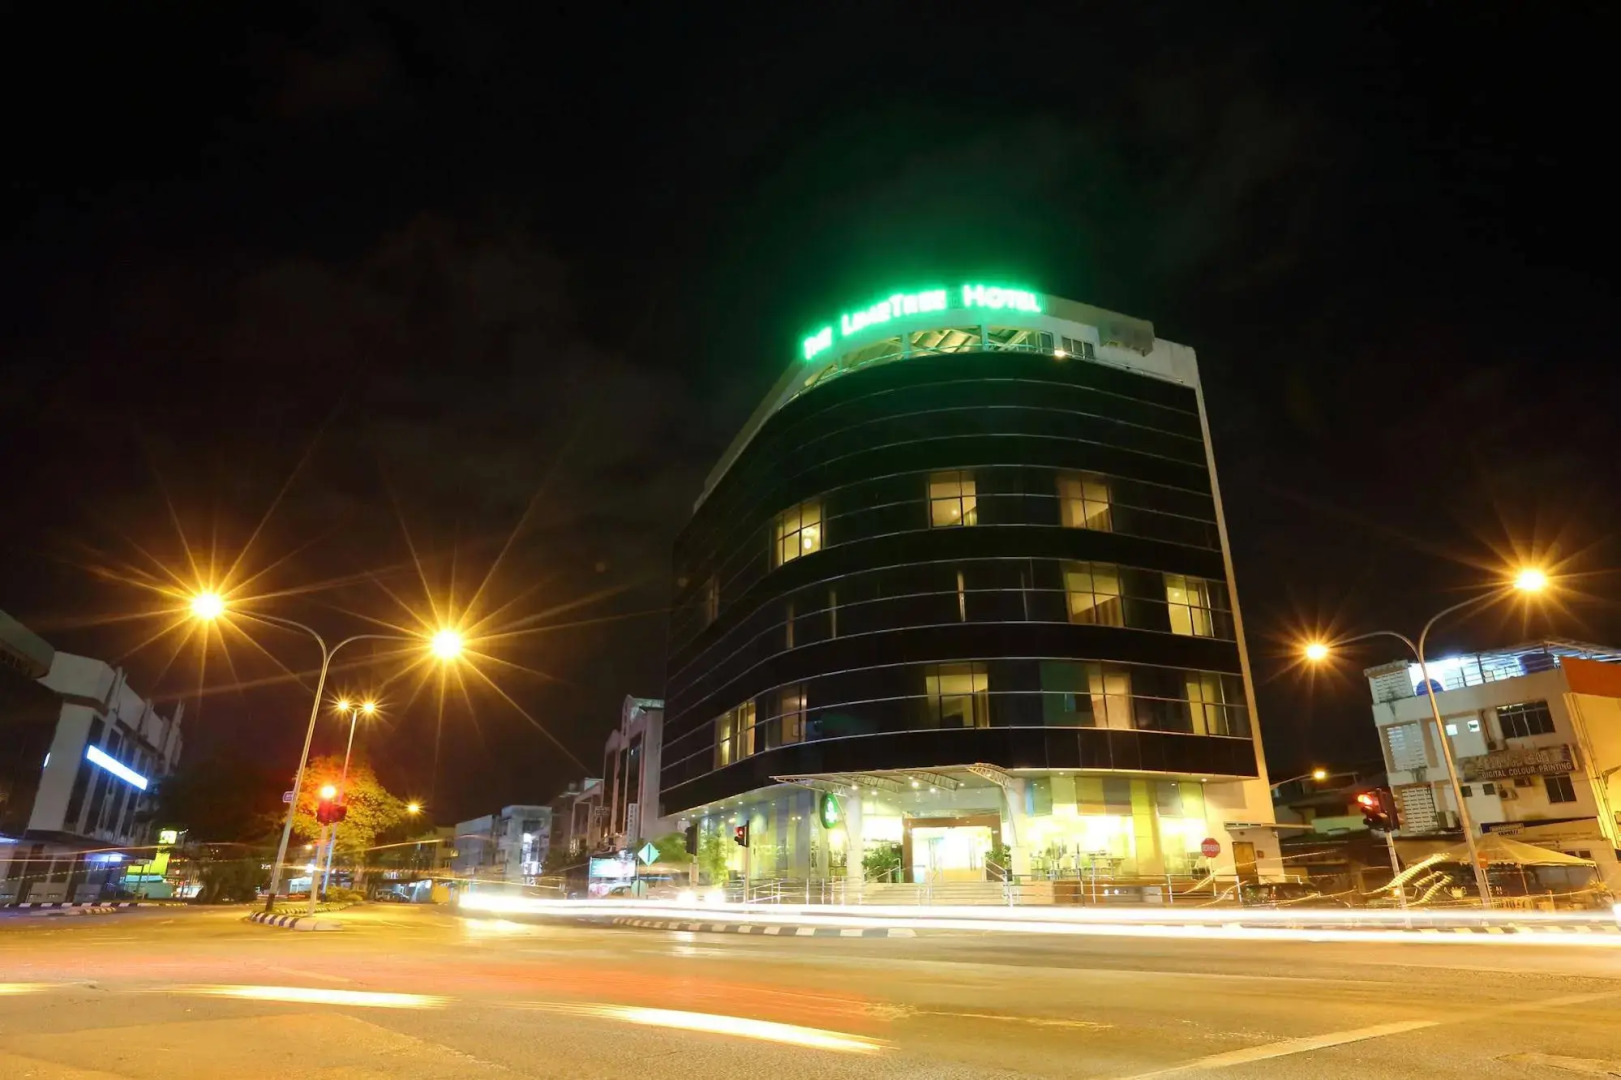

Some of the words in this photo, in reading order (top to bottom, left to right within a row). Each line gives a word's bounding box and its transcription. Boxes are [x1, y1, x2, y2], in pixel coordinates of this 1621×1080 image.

[963, 285, 1041, 313] HOTEL
[1481, 770, 1506, 779] DIGITAL
[1508, 767, 1535, 776] COLOUR
[1539, 762, 1572, 772] PRINTING
